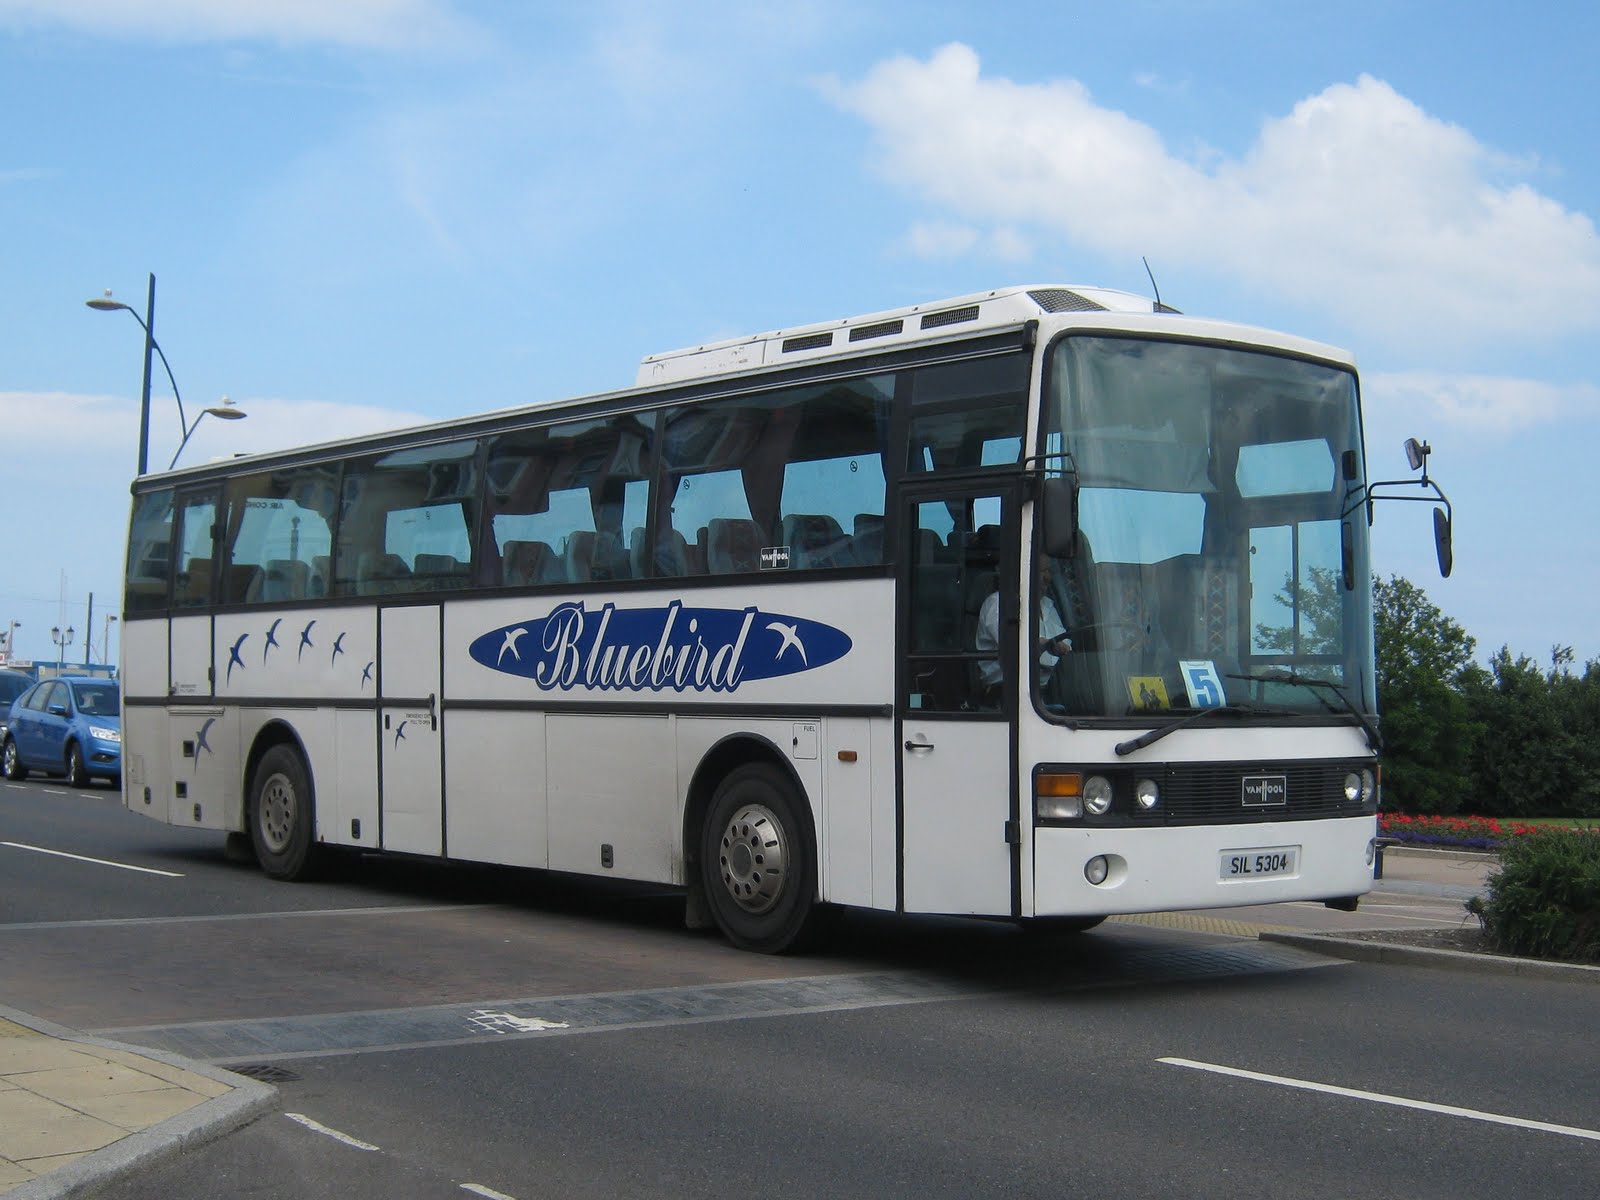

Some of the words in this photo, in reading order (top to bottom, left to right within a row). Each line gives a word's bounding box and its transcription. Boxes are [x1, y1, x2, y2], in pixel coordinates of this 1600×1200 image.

[536, 604, 755, 687] Bluebird
[1188, 669, 1221, 708] 5
[1231, 857, 1251, 874] SIL
[1255, 853, 1287, 872] 5304
